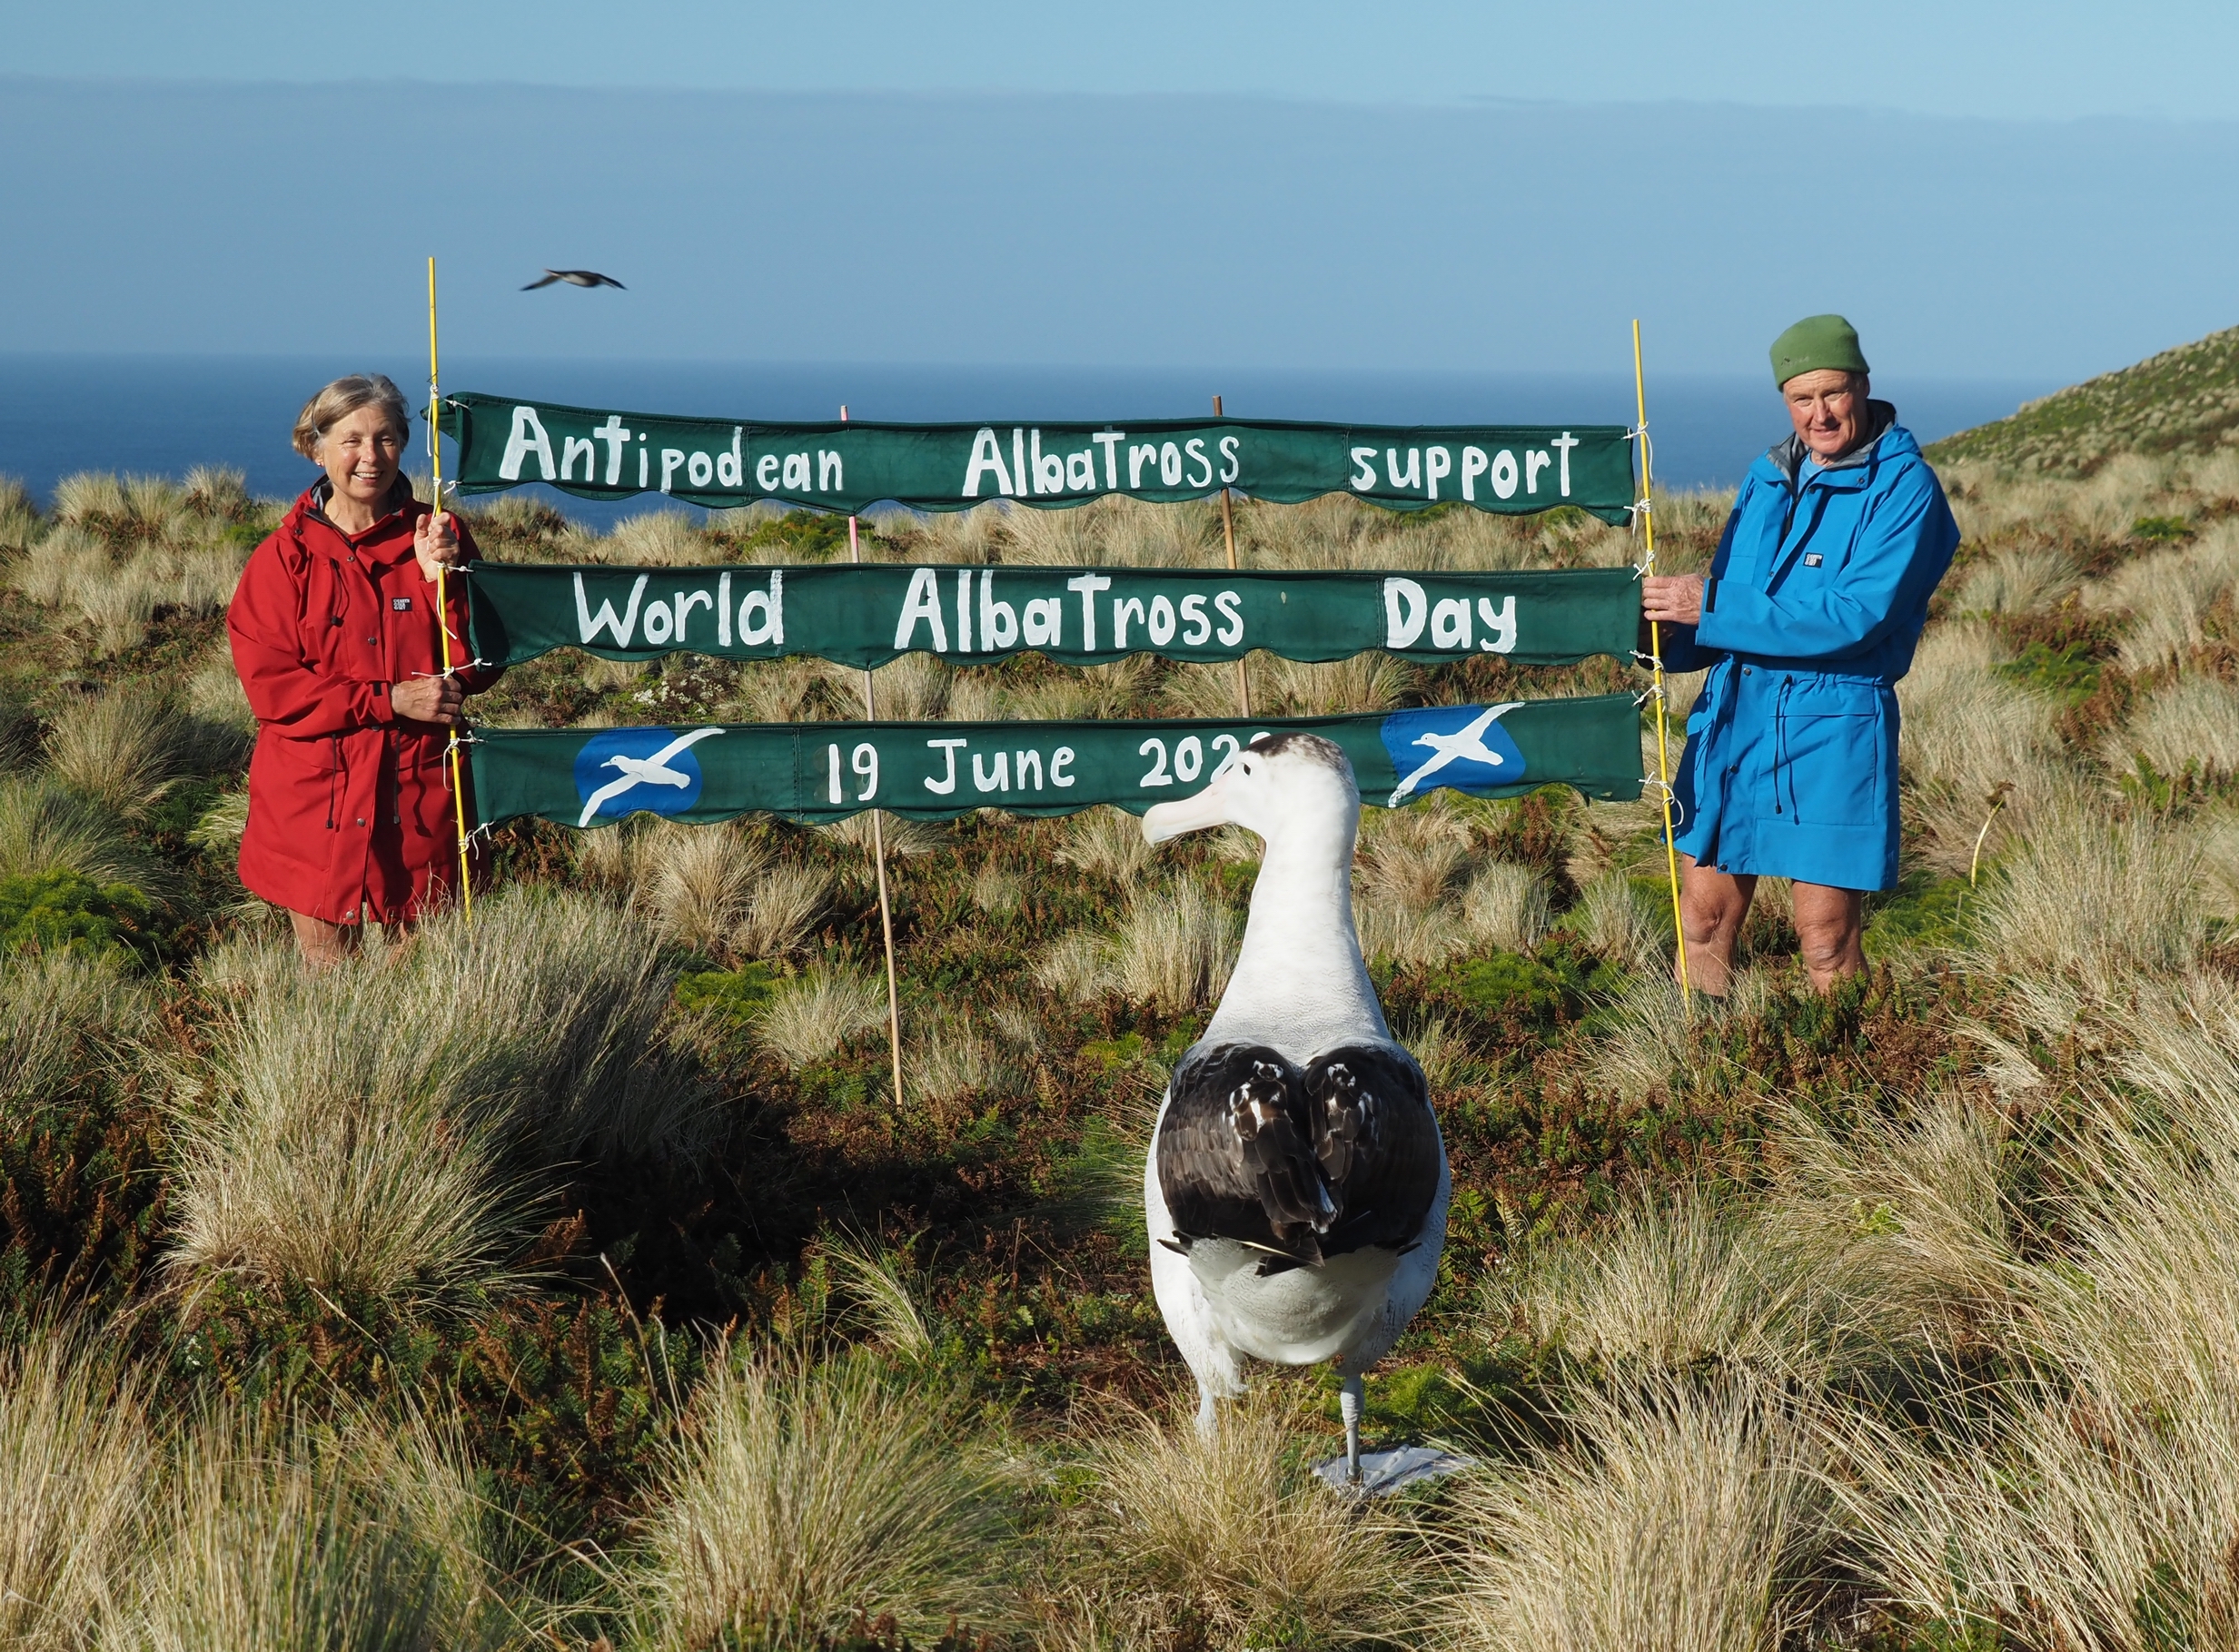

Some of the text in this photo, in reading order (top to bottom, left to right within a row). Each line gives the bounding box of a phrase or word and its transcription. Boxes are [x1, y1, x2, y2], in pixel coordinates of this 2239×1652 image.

[499, 406, 843, 493] Antipodean
[1351, 431, 1580, 500] support
[573, 569, 785, 648] World
[1383, 578, 1517, 654] Day
[827, 731, 1272, 805] 19 June 202
